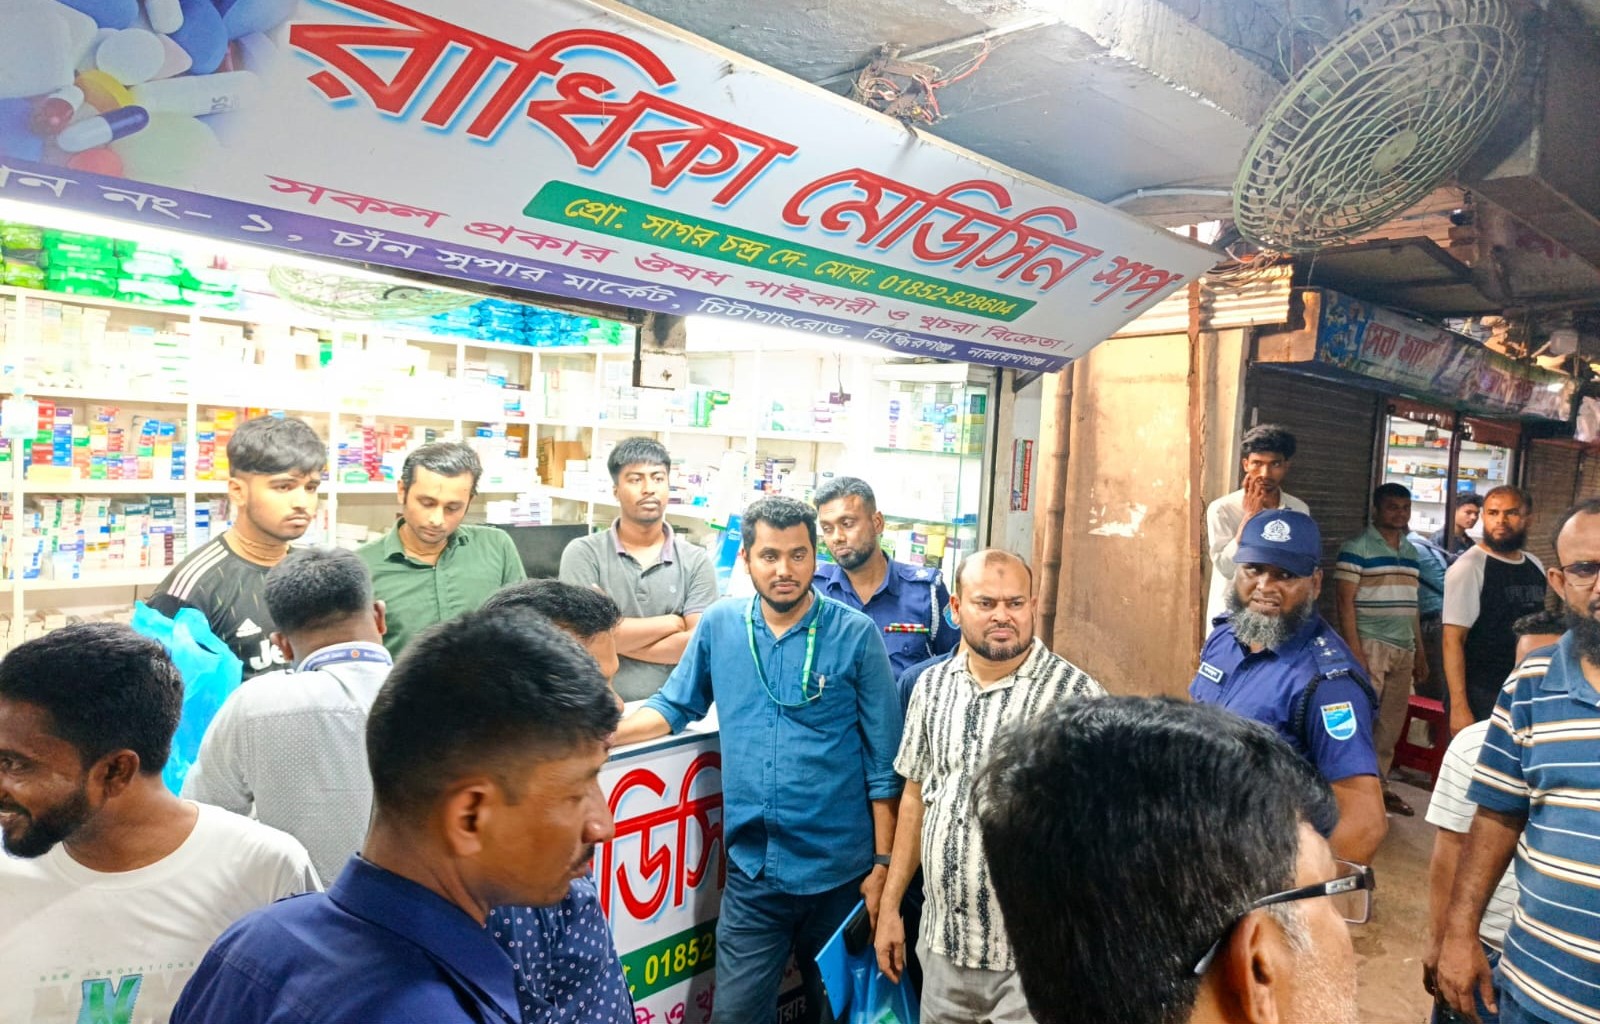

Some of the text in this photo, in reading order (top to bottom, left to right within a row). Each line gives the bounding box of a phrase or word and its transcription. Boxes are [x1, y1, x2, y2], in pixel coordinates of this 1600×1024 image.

[289, 0, 1185, 310] রাধিকা মেডিসিন শপ
[264, 173, 451, 229] সকল
[463, 221, 619, 263] প্রকার
[634, 252, 734, 287] ঔষধ
[745, 280, 881, 316] পাইকারী
[887, 308, 910, 321] ও
[919, 314, 981, 335] খুচরা
[330, 228, 425, 259] চাঁন
[435, 247, 553, 283] সুপার
[564, 198, 628, 230] প্রো.
[641, 213, 720, 248] সাগর
[718, 233, 772, 263] চন্দ্র
[877, 274, 1019, 316] 01852-828604
[249, 638, 291, 670] Je
[645, 932, 715, 986] 01852
